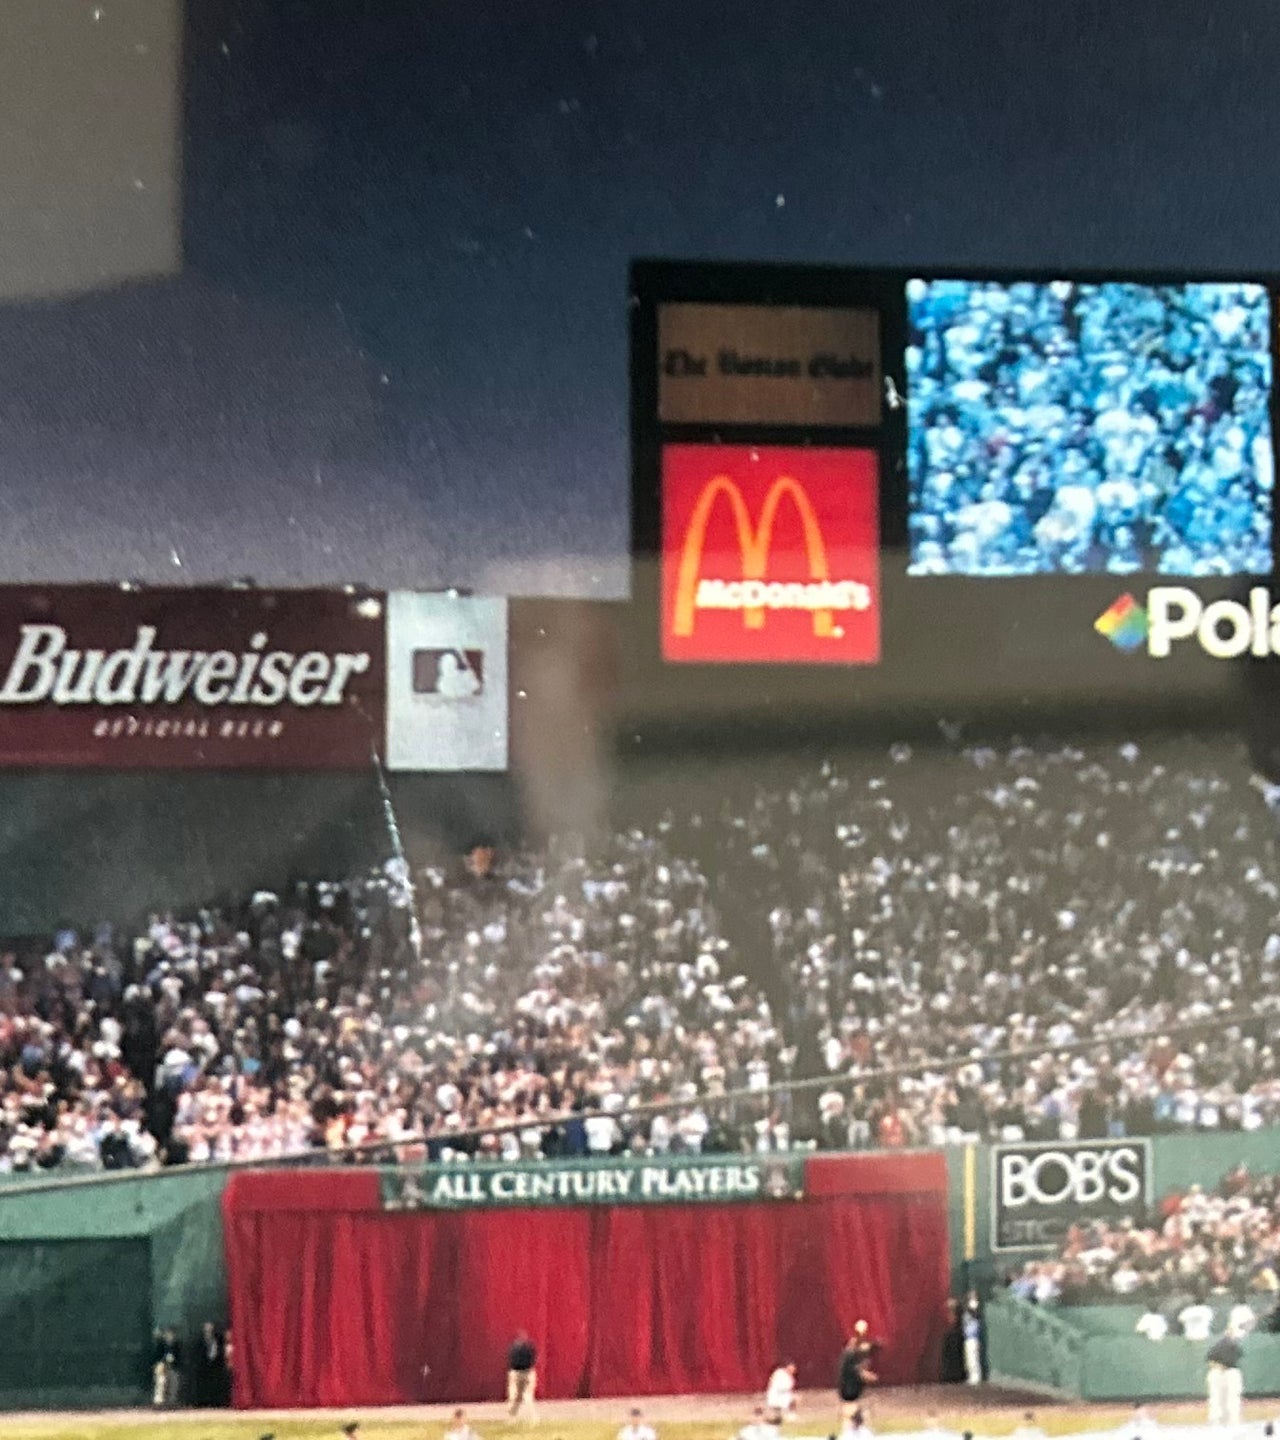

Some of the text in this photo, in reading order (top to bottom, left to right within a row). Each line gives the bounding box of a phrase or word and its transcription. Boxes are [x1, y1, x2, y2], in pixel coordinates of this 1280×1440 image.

[433, 1165, 760, 1201] ALL CENTURY PLAYERS
[1001, 1148, 1141, 1208] BOB'S
